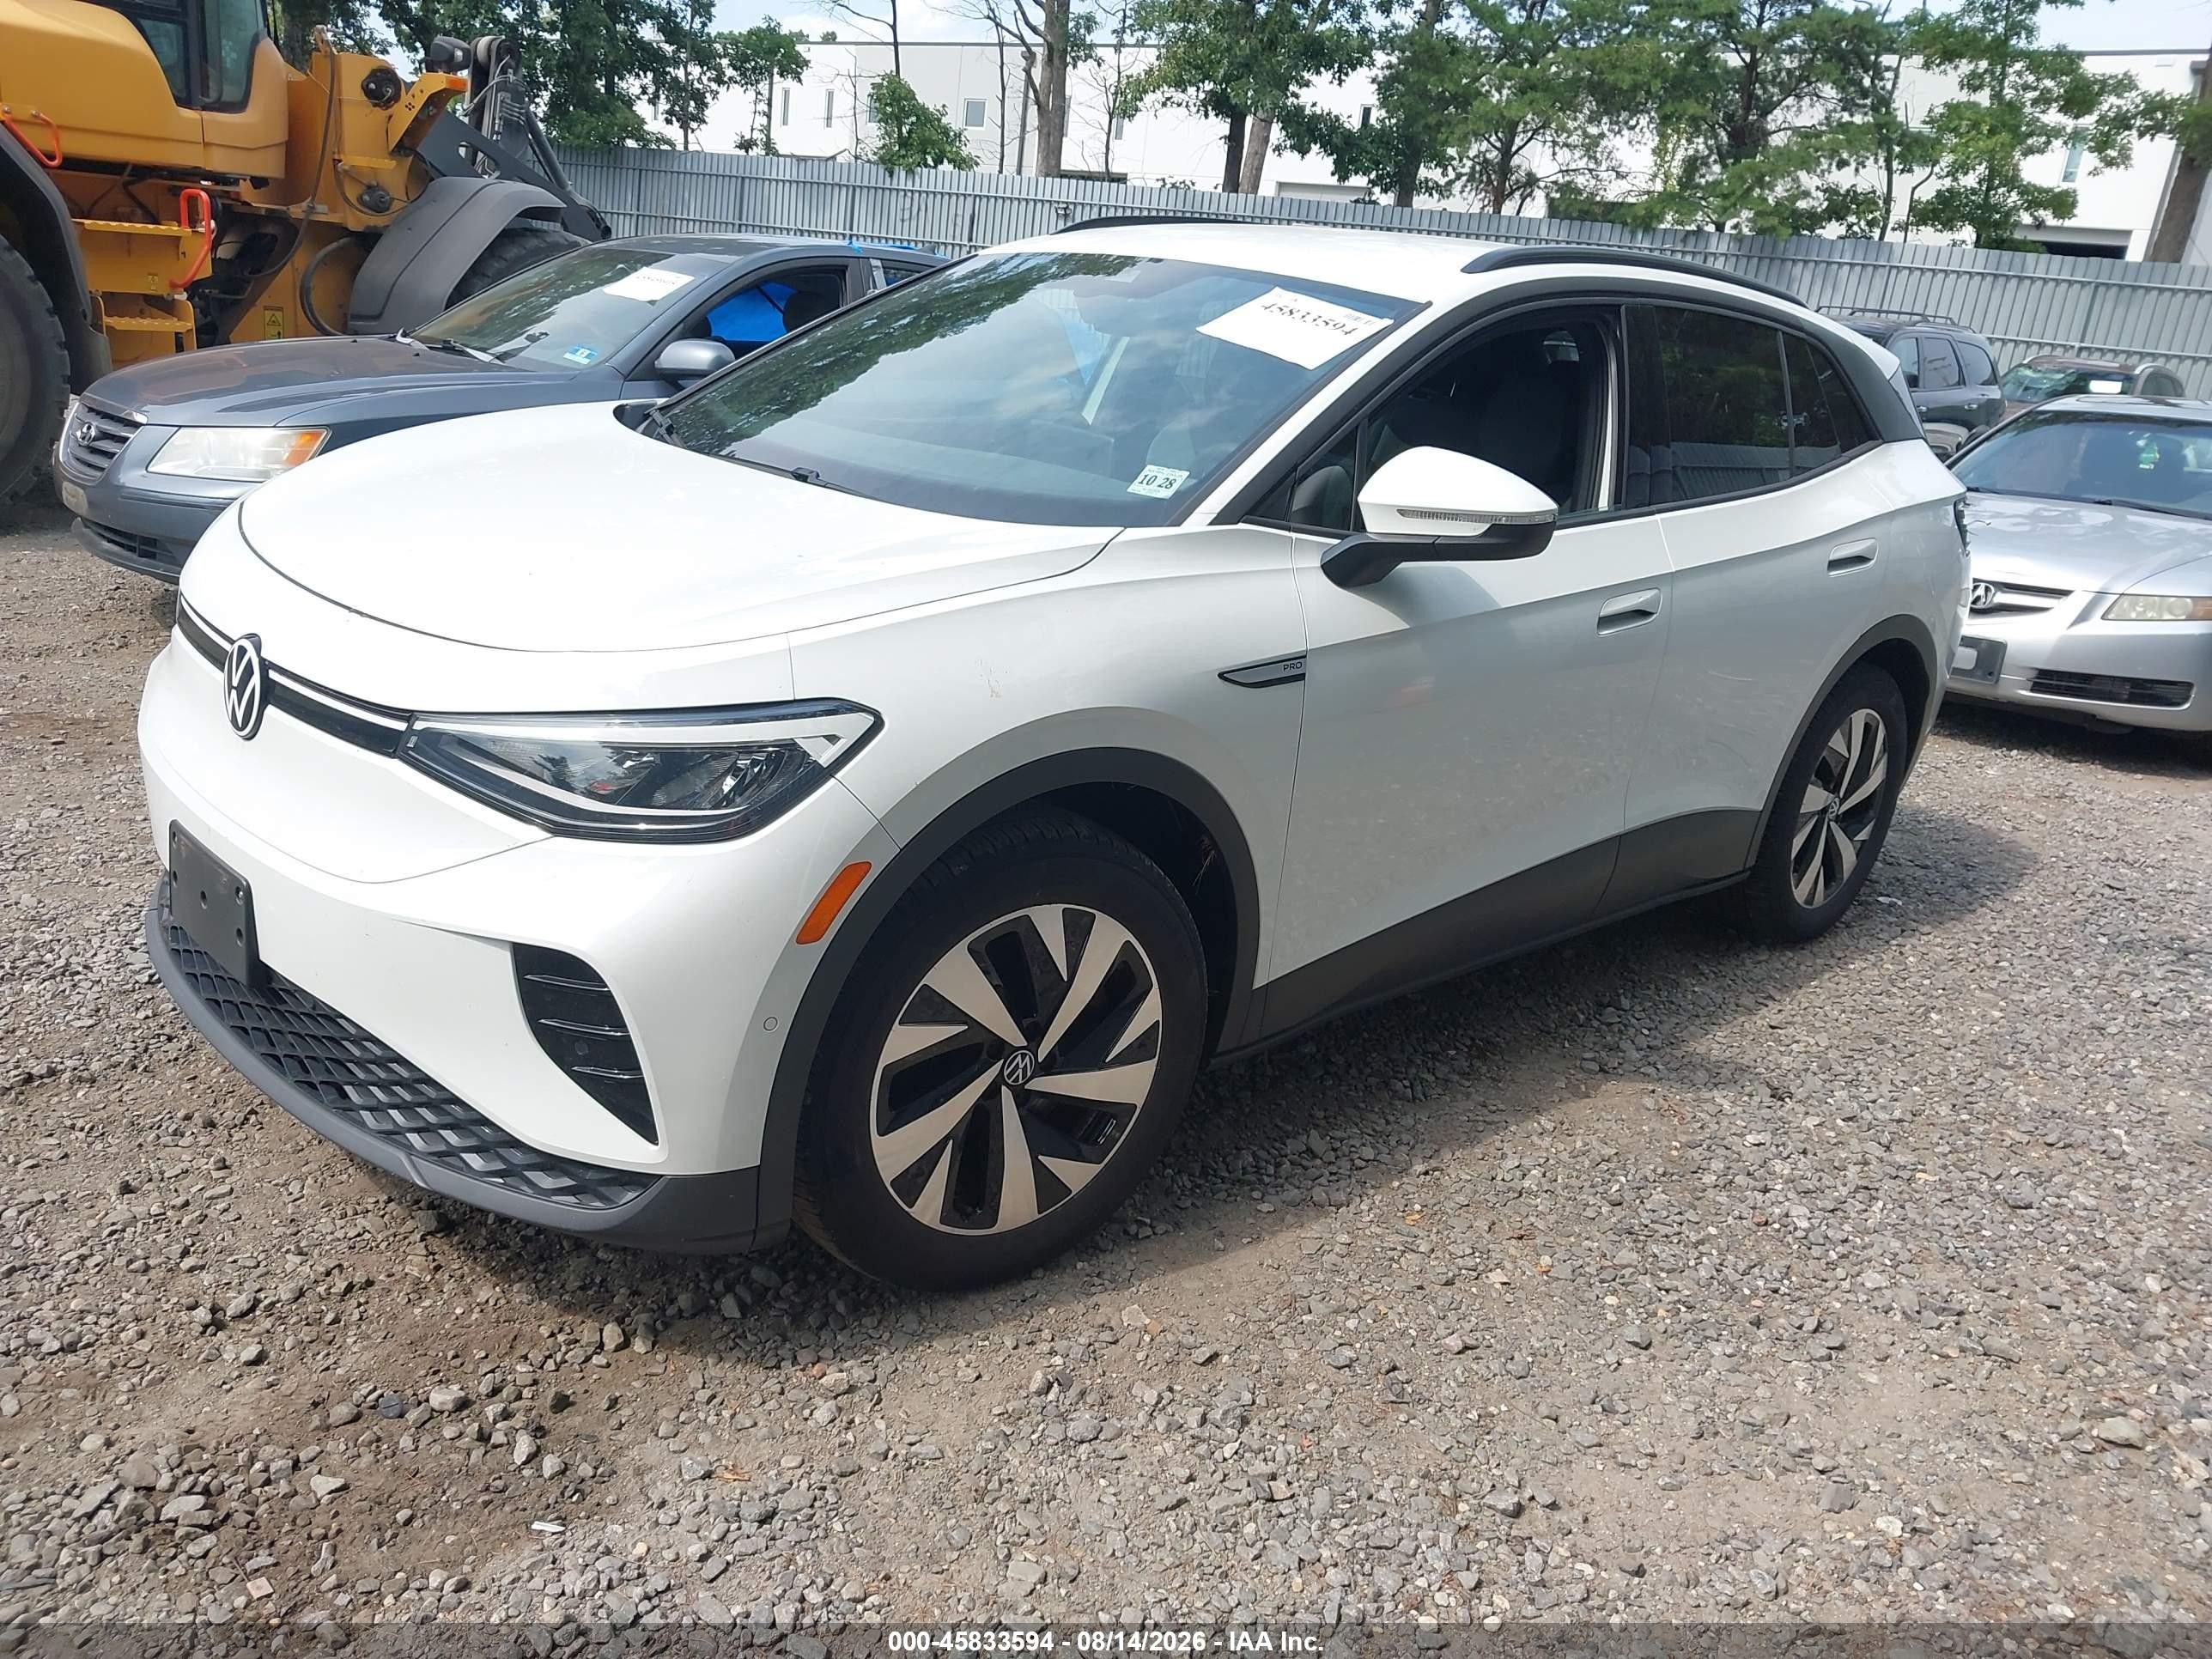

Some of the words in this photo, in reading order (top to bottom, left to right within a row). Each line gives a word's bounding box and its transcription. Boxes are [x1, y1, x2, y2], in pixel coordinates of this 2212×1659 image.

[1138, 473, 1158, 486] 10
[1157, 477, 1176, 489] 28
[1283, 661, 1303, 672] PRO
